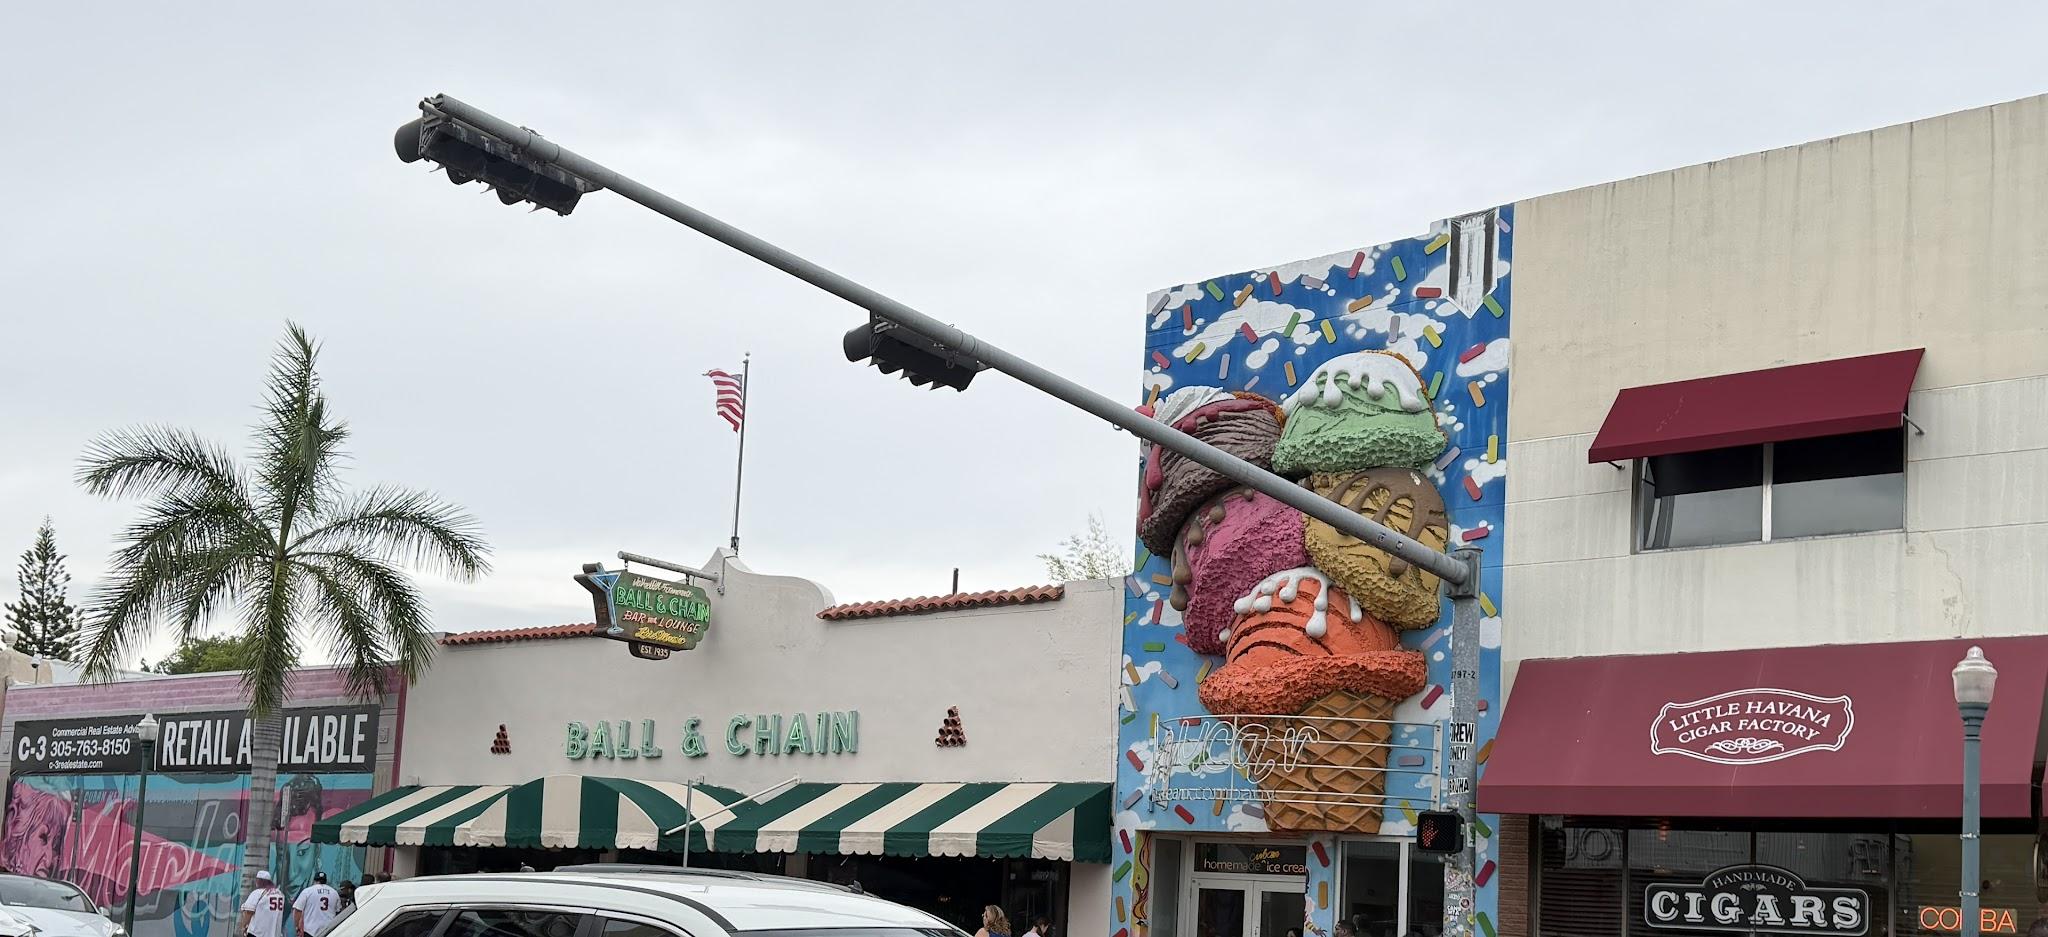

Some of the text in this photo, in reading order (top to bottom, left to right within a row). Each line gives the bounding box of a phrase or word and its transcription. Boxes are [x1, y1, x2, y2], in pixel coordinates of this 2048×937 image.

[615, 586, 710, 622] BALL & CHAIN
[623, 610, 646, 624] BAR
[658, 617, 701, 634] LOUNGE
[654, 647, 669, 658] 1935
[1669, 701, 1831, 732] LITTLE HAVANA
[52, 727, 87, 737] Commercial
[88, 726, 102, 735] Real
[103, 725, 122, 734] Estate
[161, 713, 368, 766] RETAIL AILABLE
[565, 708, 859, 760] BALL & CHAIN
[1678, 718, 1821, 744] CIGAR FACTORY
[18, 736, 47, 761] C-3
[50, 738, 130, 757] 305-763-8150
[48, 760, 103, 769] c-3realestate.com
[1204, 859, 1260, 871] homemade
[1266, 861, 1280, 872] ice
[1713, 872, 1797, 891] HANDMADE
[319, 896, 329, 911] 3
[1651, 891, 1861, 929] CIGARS
[1920, 906, 2017, 932] COBA
